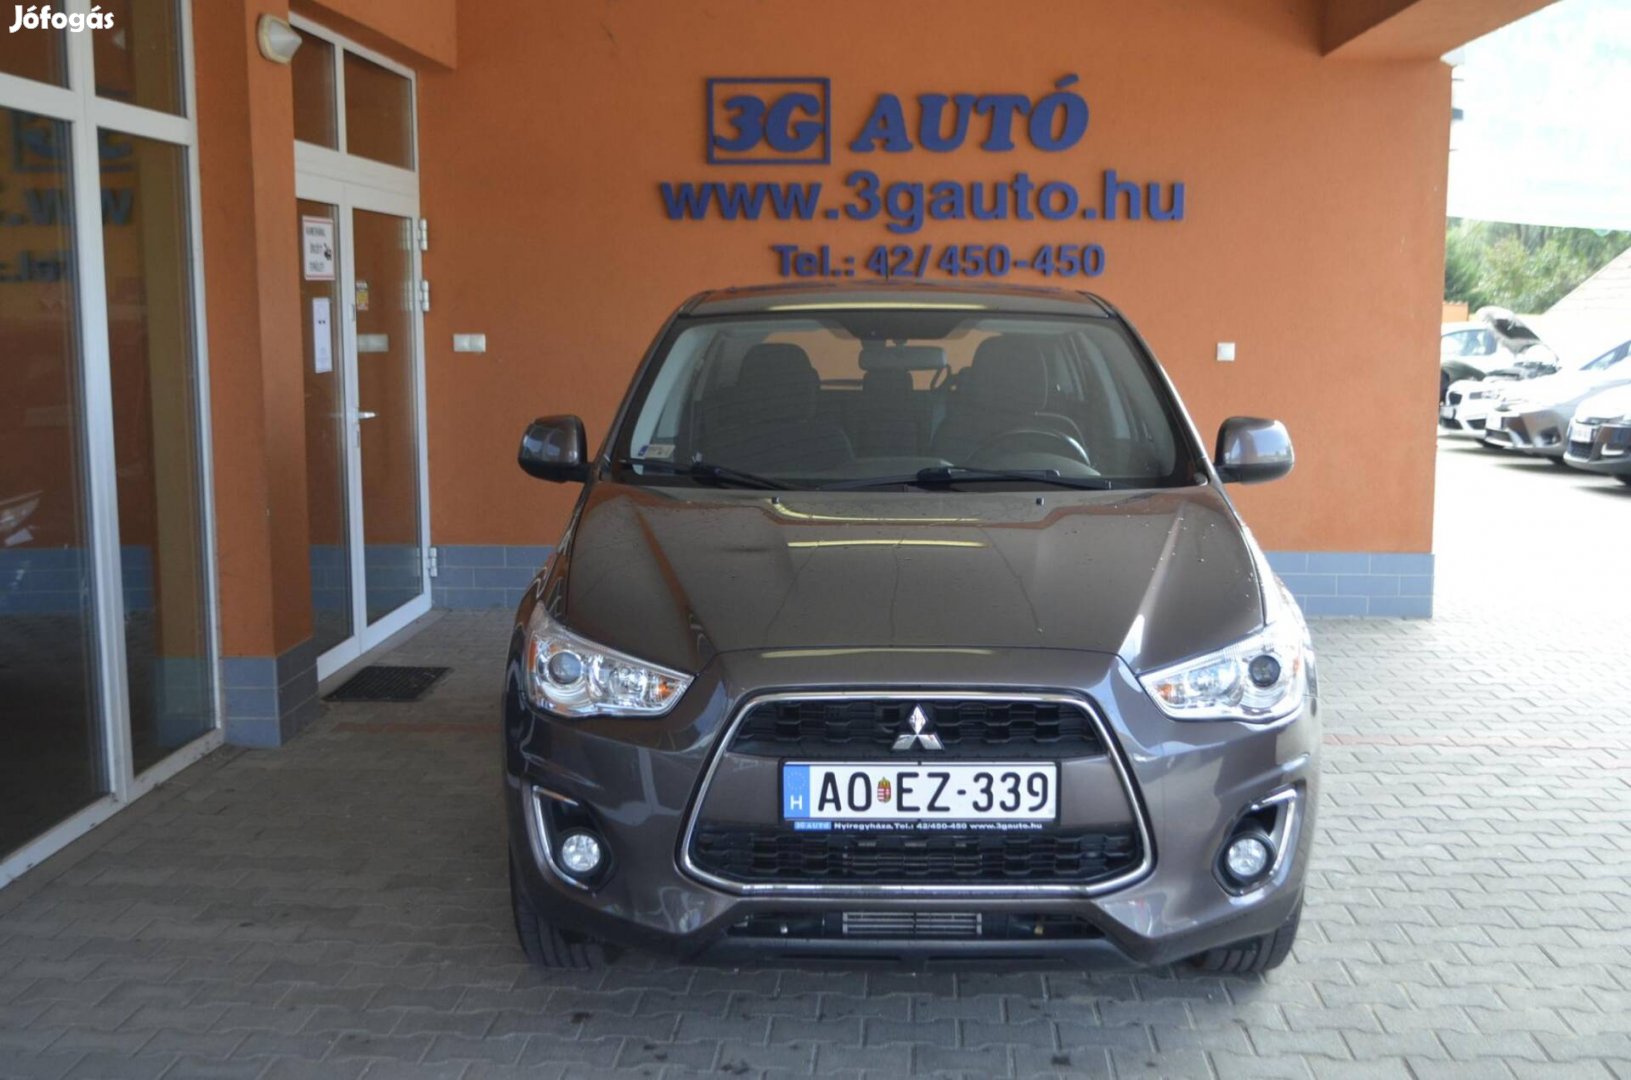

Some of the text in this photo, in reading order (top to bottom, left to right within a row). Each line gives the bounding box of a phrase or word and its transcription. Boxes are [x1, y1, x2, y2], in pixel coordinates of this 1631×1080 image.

[712, 73, 1090, 152] 3G AUTÓ
[660, 168, 1186, 234] www.3gauto.hu
[772, 244, 855, 277] Tel.:
[790, 795, 803, 810] H
[895, 771, 1050, 813] EZ-339
